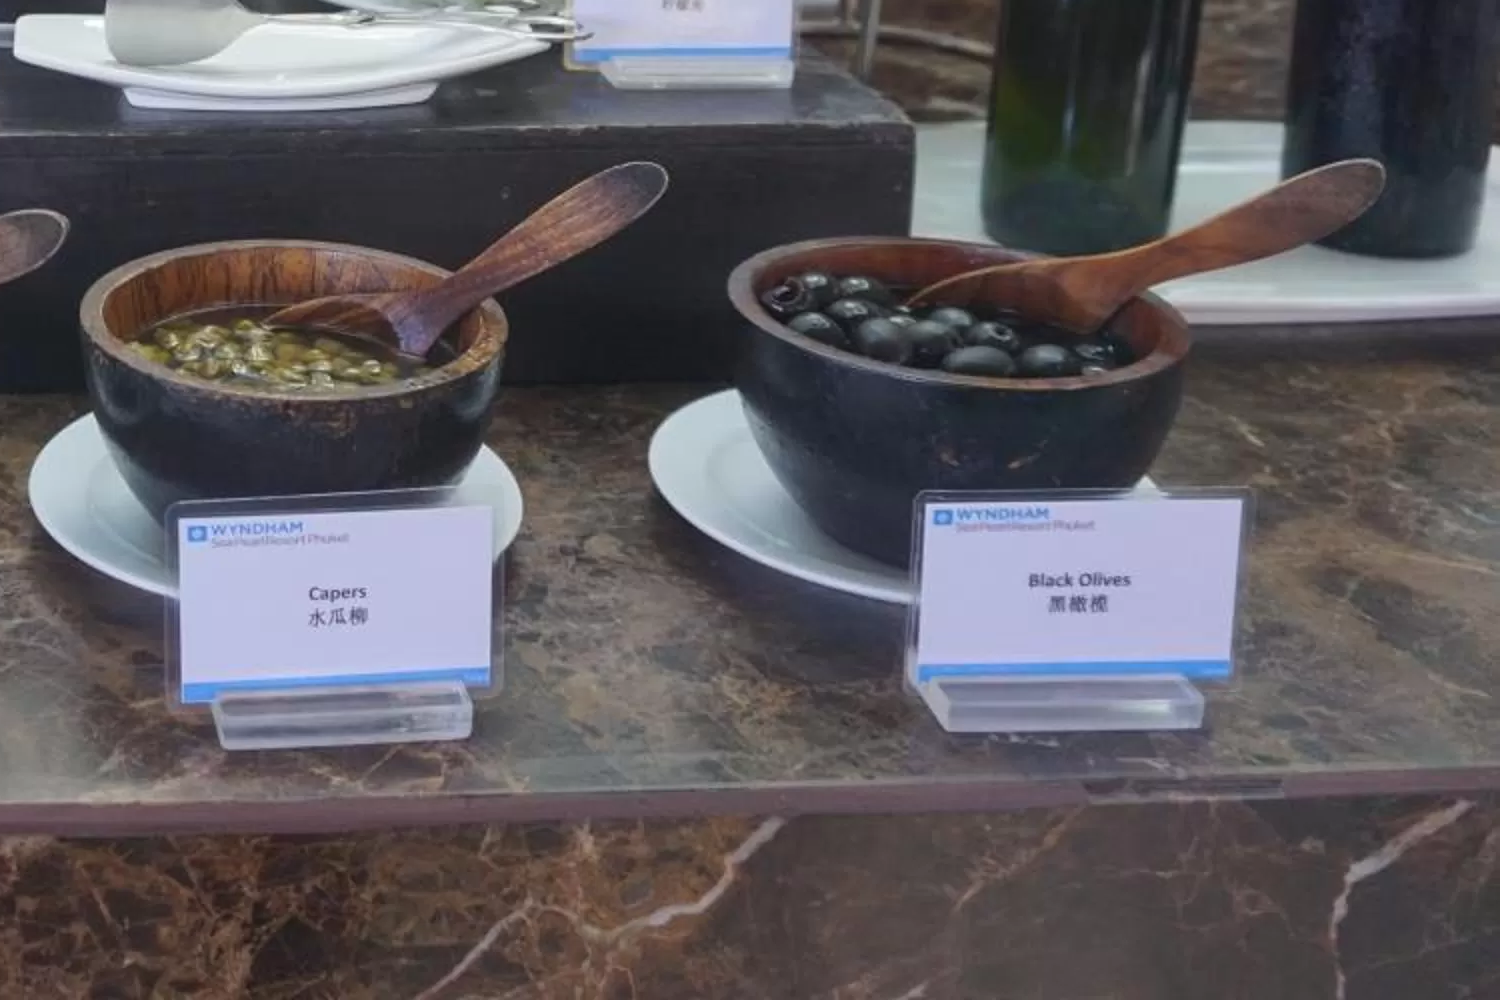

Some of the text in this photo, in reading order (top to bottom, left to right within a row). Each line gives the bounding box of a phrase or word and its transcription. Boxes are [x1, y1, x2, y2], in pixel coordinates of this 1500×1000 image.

[957, 507, 1049, 521] WYNDHAM
[211, 521, 303, 536] WYNDHAM
[1029, 572, 1132, 587] Black Olives
[308, 586, 368, 603] Capers
[308, 606, 369, 628] 水瓜柳
